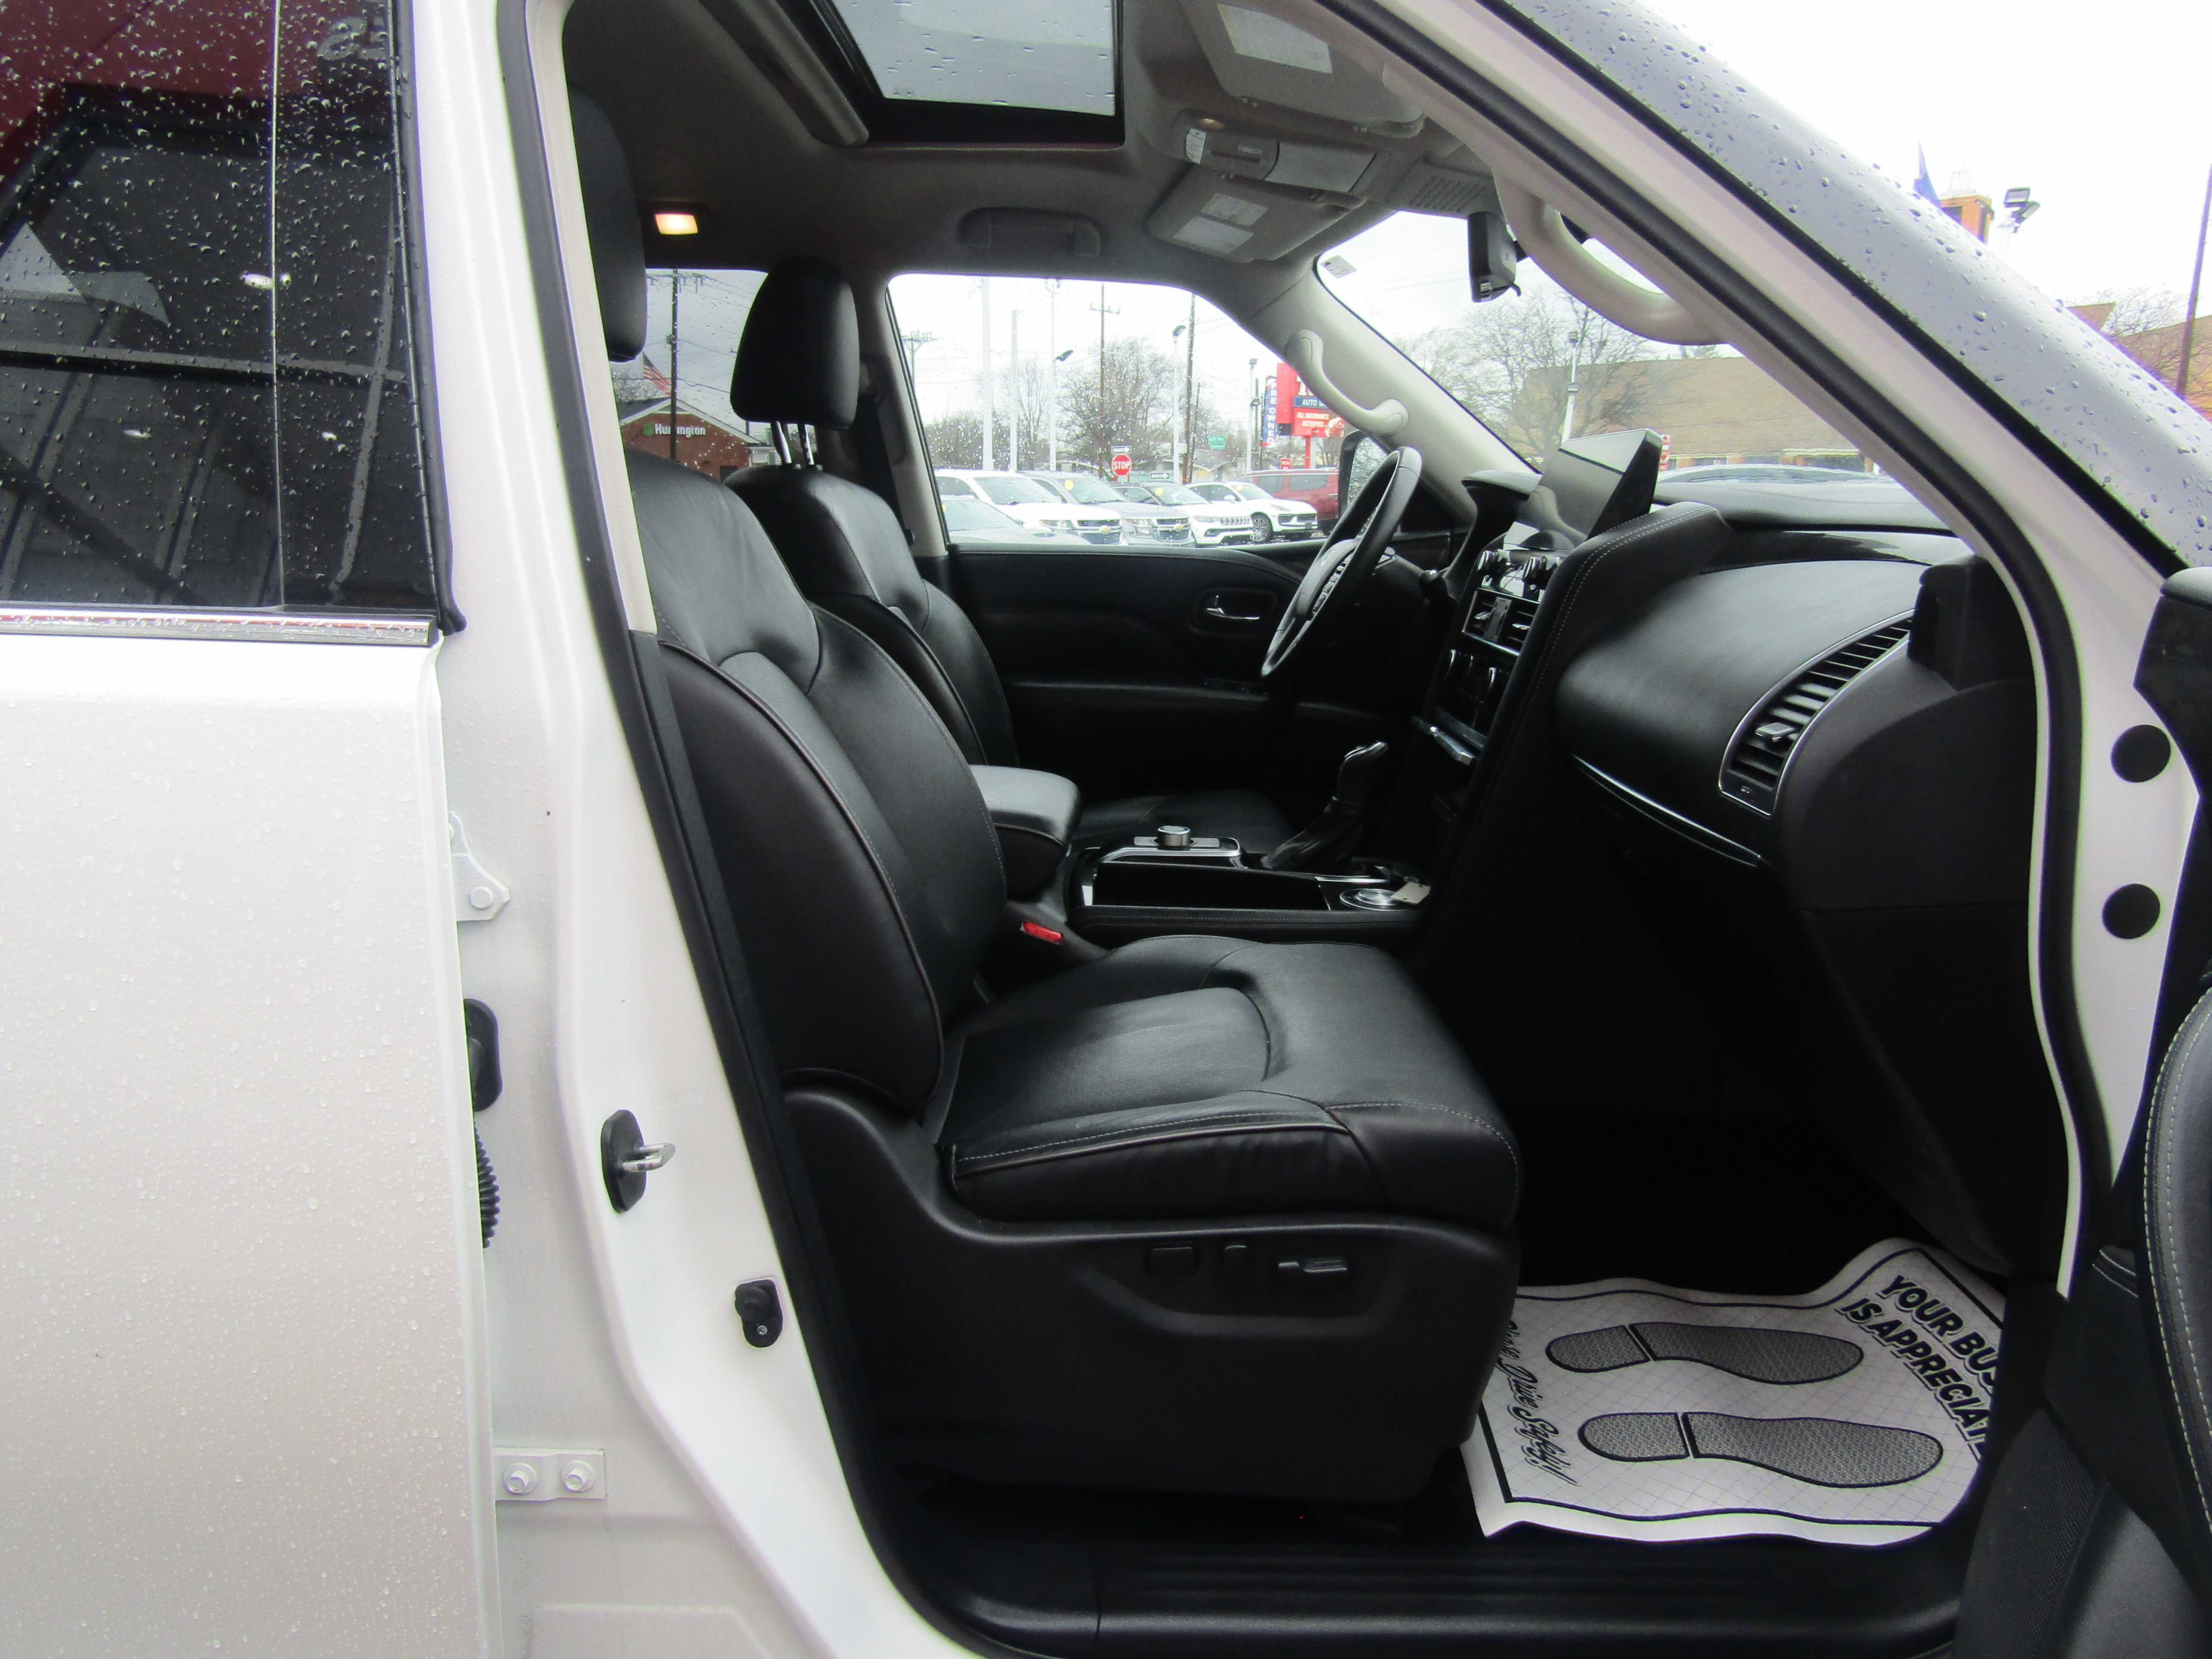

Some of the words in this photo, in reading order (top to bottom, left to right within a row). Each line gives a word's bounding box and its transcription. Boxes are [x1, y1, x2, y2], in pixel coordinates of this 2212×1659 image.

[1302, 398, 1317, 407] AUTO
[655, 423, 705, 438] Huington
[1266, 407, 1277, 445] OWNED
[1113, 461, 1130, 470] STOP
[1838, 1297, 1883, 1323] IS
[1877, 1274, 1964, 1340] YOUR
[1495, 1356, 1543, 1410] Drive
